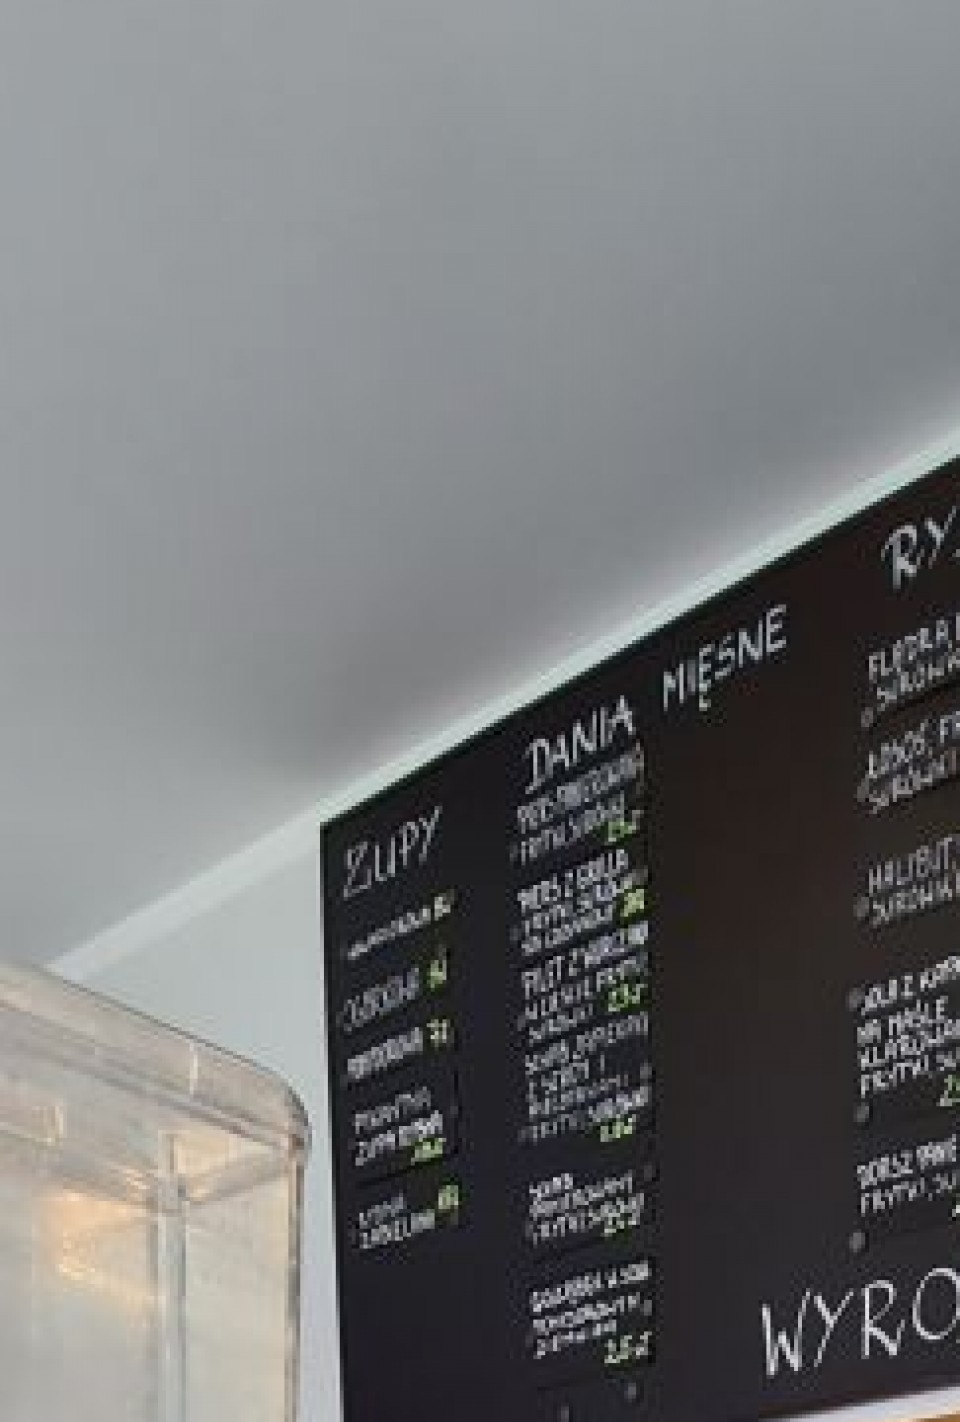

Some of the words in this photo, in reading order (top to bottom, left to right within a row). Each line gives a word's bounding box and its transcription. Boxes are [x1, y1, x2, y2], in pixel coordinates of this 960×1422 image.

[525, 695, 635, 794] DANIA
[662, 604, 788, 711] MIĘSNE
[343, 806, 443, 899] ZUPY
